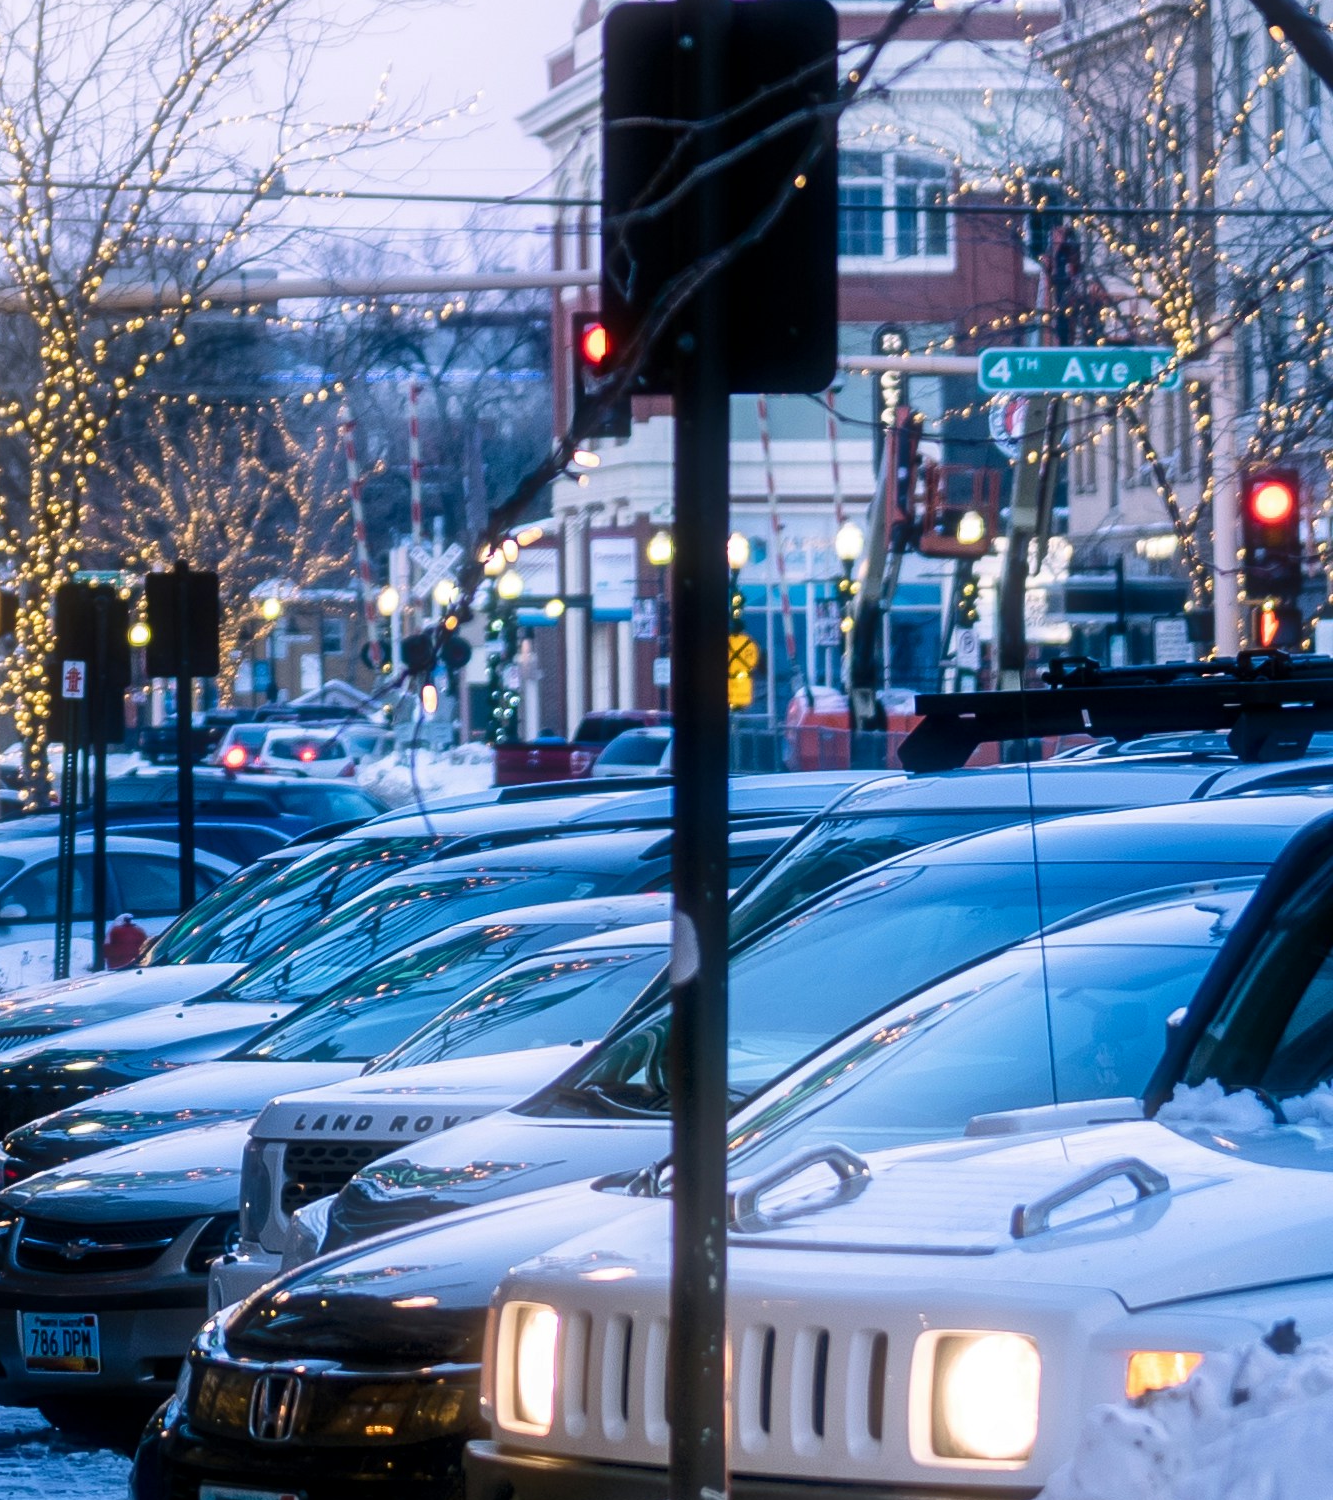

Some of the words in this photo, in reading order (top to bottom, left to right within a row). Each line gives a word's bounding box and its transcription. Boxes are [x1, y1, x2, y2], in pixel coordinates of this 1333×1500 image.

[988, 356, 1039, 383] 4TH
[1062, 356, 1129, 383] Ave
[294, 1114, 374, 1131] LAND
[388, 1115, 482, 1132] ROV
[31, 1329, 59, 1356] 786
[63, 1329, 92, 1357] DPM
